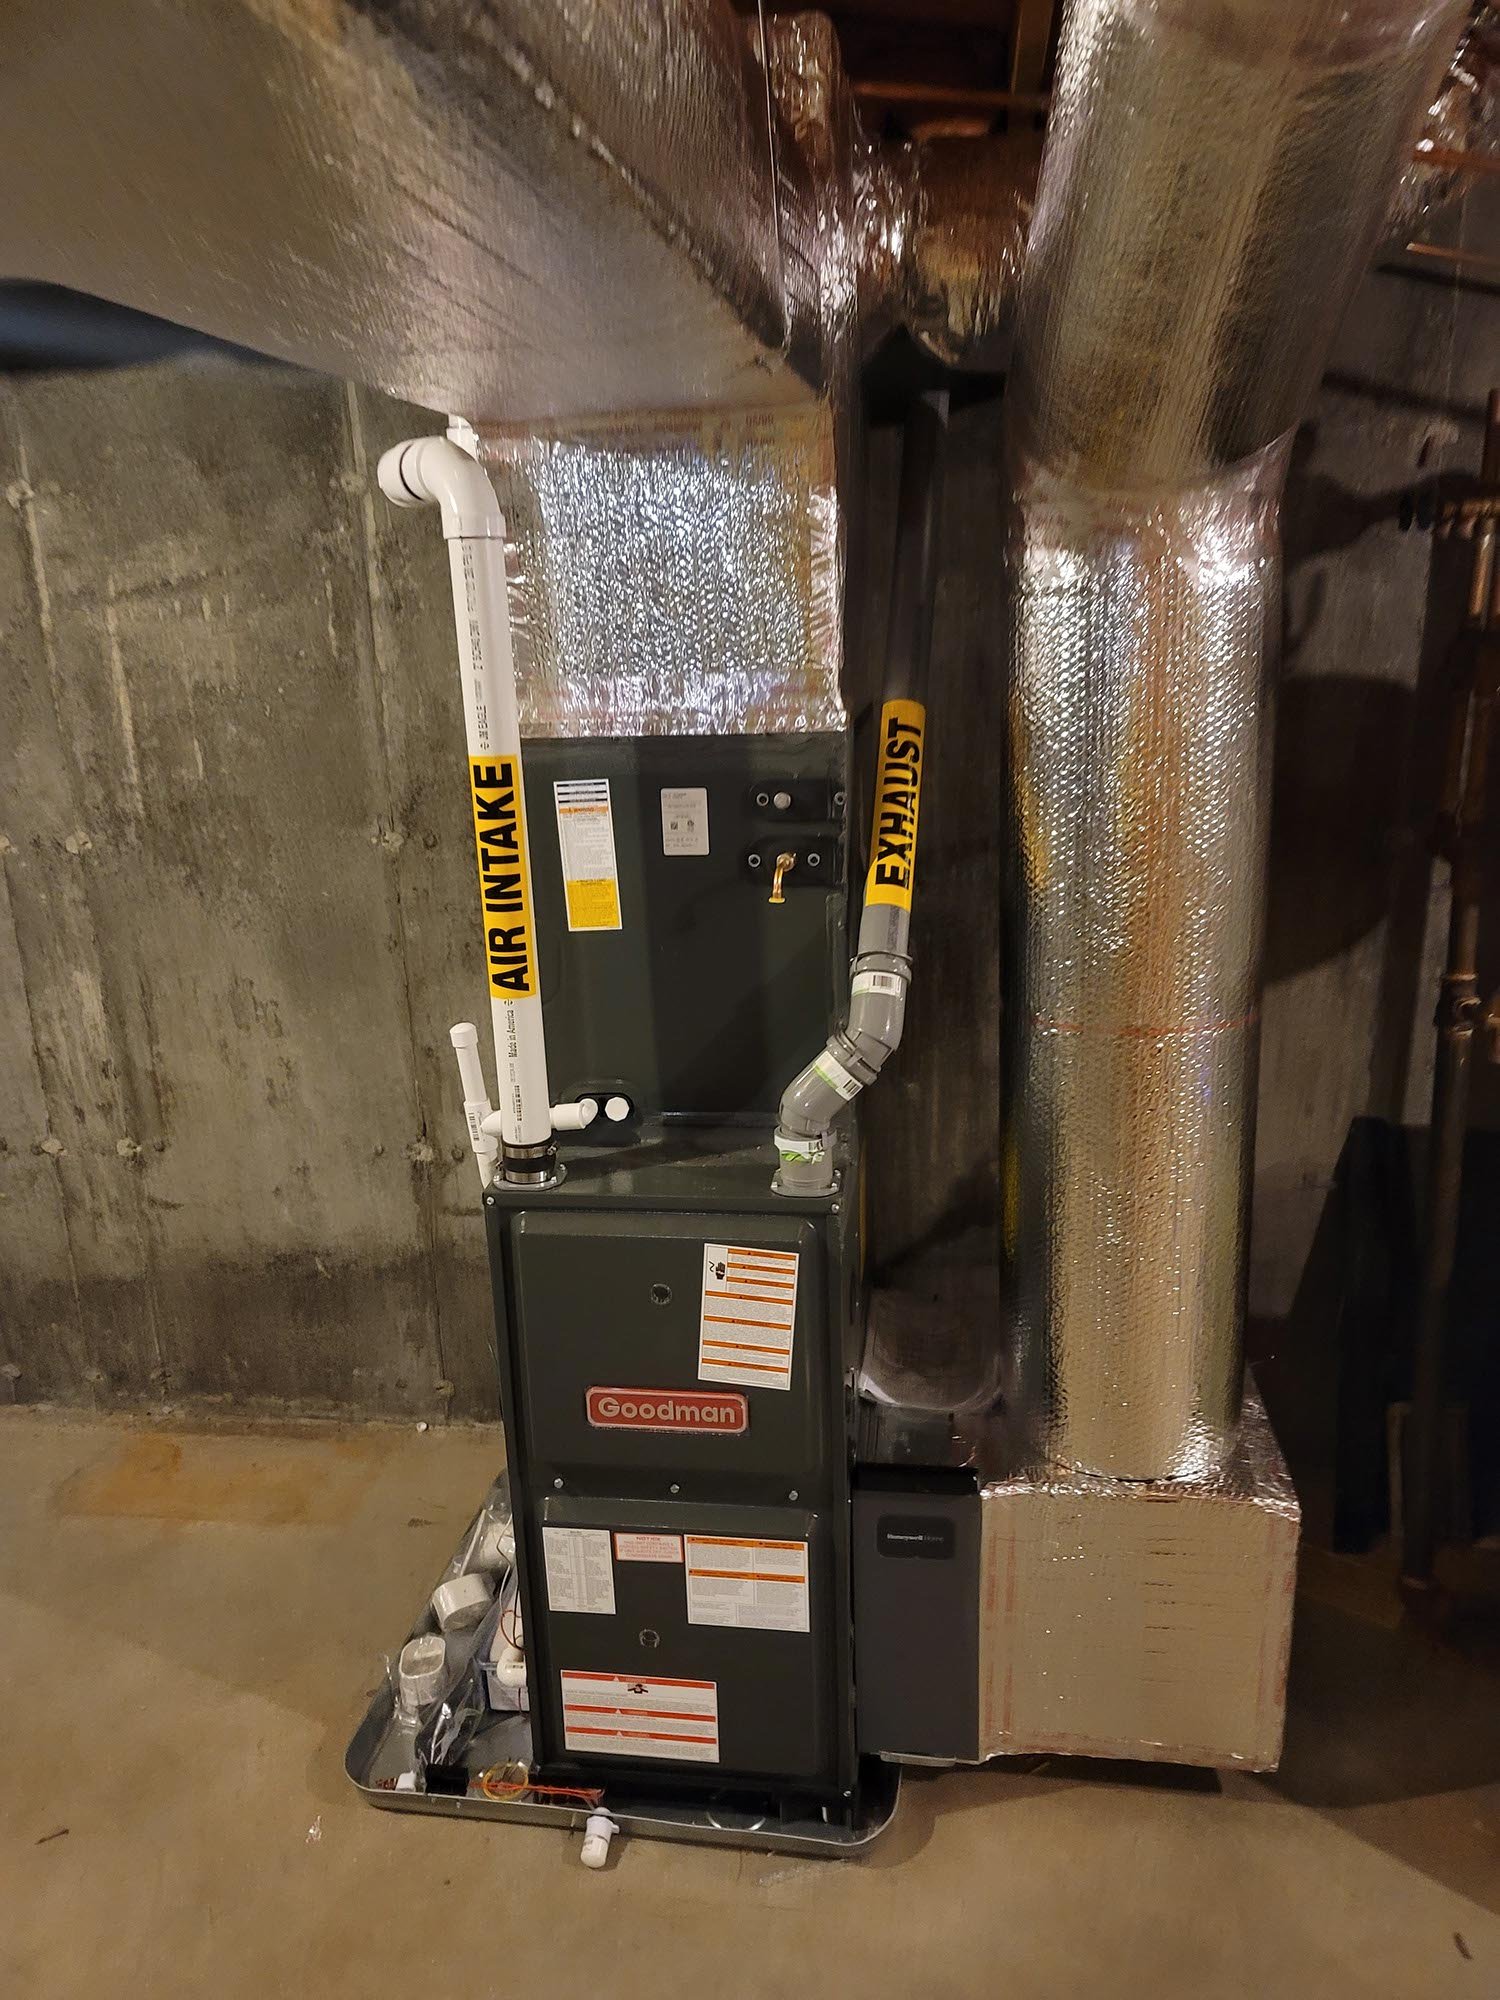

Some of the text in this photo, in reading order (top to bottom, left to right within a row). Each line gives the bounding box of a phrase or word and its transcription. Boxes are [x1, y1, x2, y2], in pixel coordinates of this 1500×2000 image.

[875, 717, 922, 890] EXHAUST
[473, 763, 530, 992] AIR INTAKE
[506, 1010, 516, 1033] America
[508, 1042, 518, 1058] Made
[598, 1396, 735, 1423] Goodman
